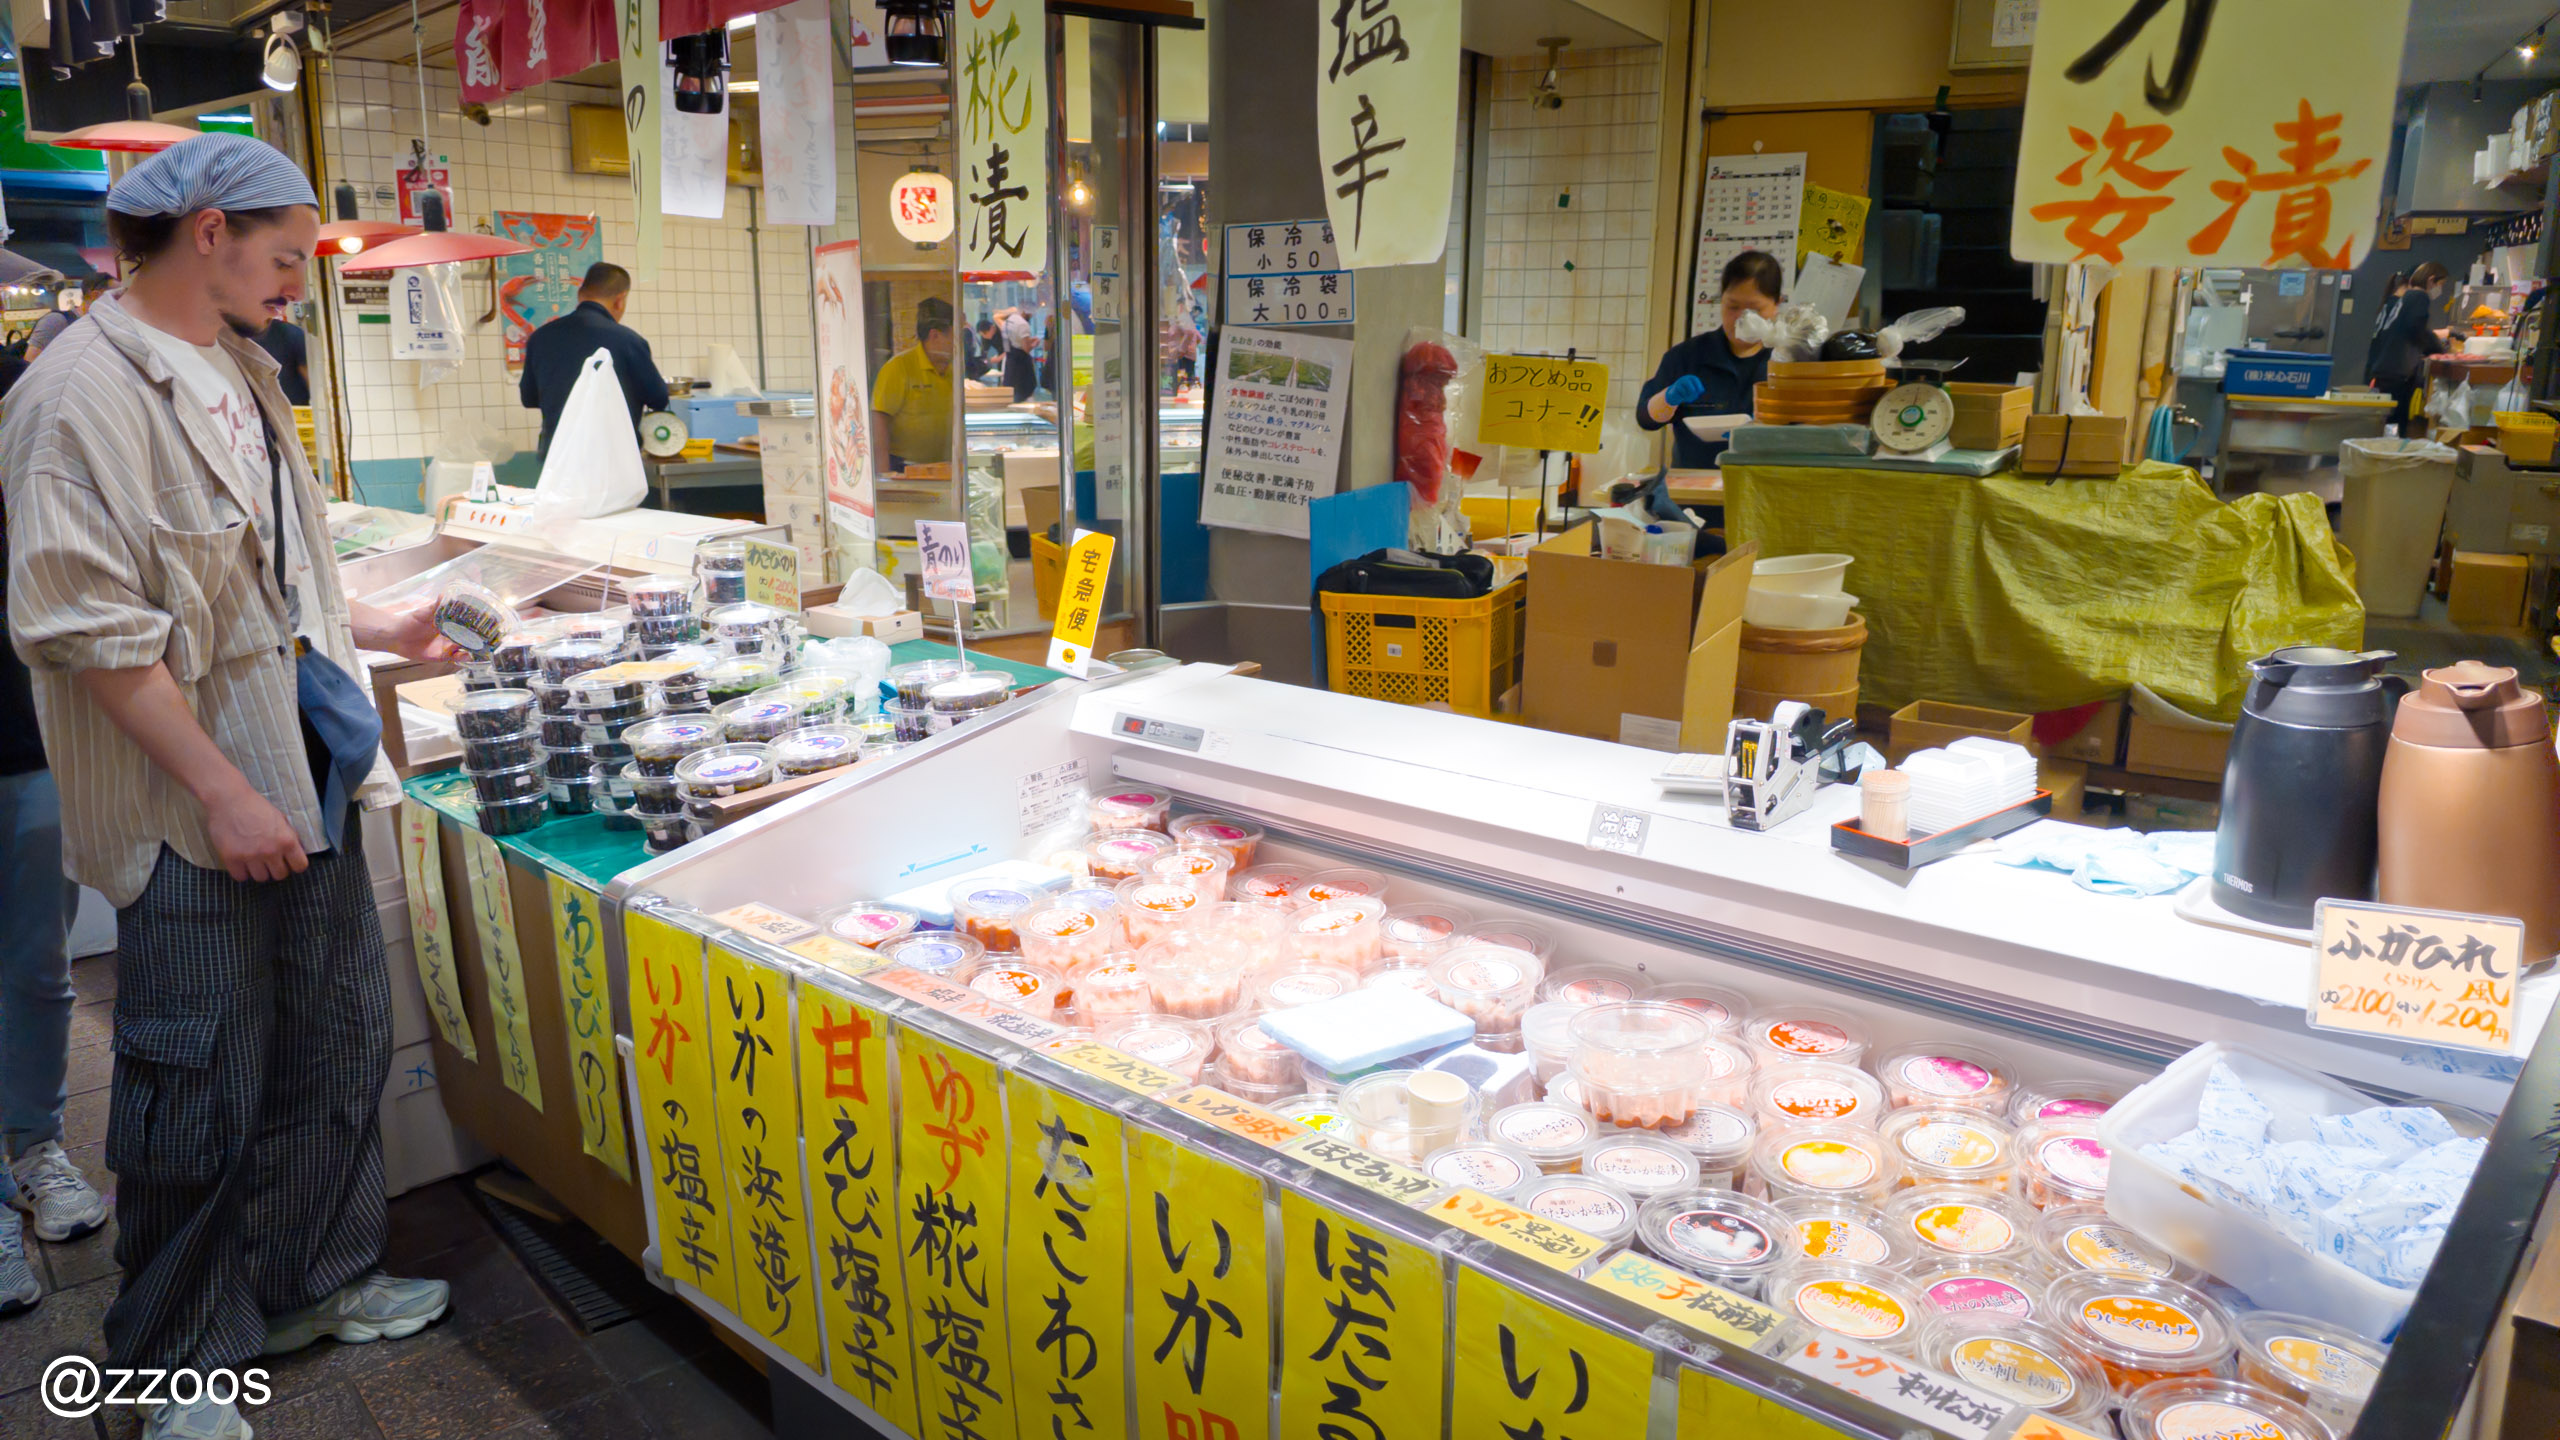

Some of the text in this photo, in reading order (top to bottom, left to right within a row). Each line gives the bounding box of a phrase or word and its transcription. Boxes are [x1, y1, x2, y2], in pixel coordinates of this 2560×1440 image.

[962, 0, 1033, 262] 糀漬
[1328, 0, 1410, 253] 塩辛
[2029, 97, 2373, 270] 姿漬
[1247, 274, 1337, 298] 保冷袋
[1489, 362, 1593, 392] おつとめ品
[1221, 468, 1315, 492] 便秘改善・肥満予防
[747, 544, 797, 576] わさびのり
[922, 524, 965, 576] 青のり
[1067, 548, 1101, 632] 宅急便
[1599, 811, 1643, 839] 冷凍
[2223, 873, 2253, 893] THERMOS
[2327, 918, 2510, 979] ふかひれ
[562, 892, 608, 1148] わさびのり
[642, 956, 720, 1287] いかの塩辛
[1176, 1093, 1298, 1143] いか明太
[725, 975, 801, 1338] いかの浜造り
[1302, 1139, 1441, 1196] ほたるいか
[811, 1003, 900, 1410] 甘えび塩辛
[1443, 1193, 1593, 1261] いかの黒造り
[909, 1051, 1003, 1440] ゆず糀塩辛
[1609, 1252, 1778, 1339] 数の子松前漬
[2086, 1306, 2192, 1339] うにくらげ
[1496, 1322, 1591, 1440] い
[1960, 1356, 2064, 1394] いか刺し松前
